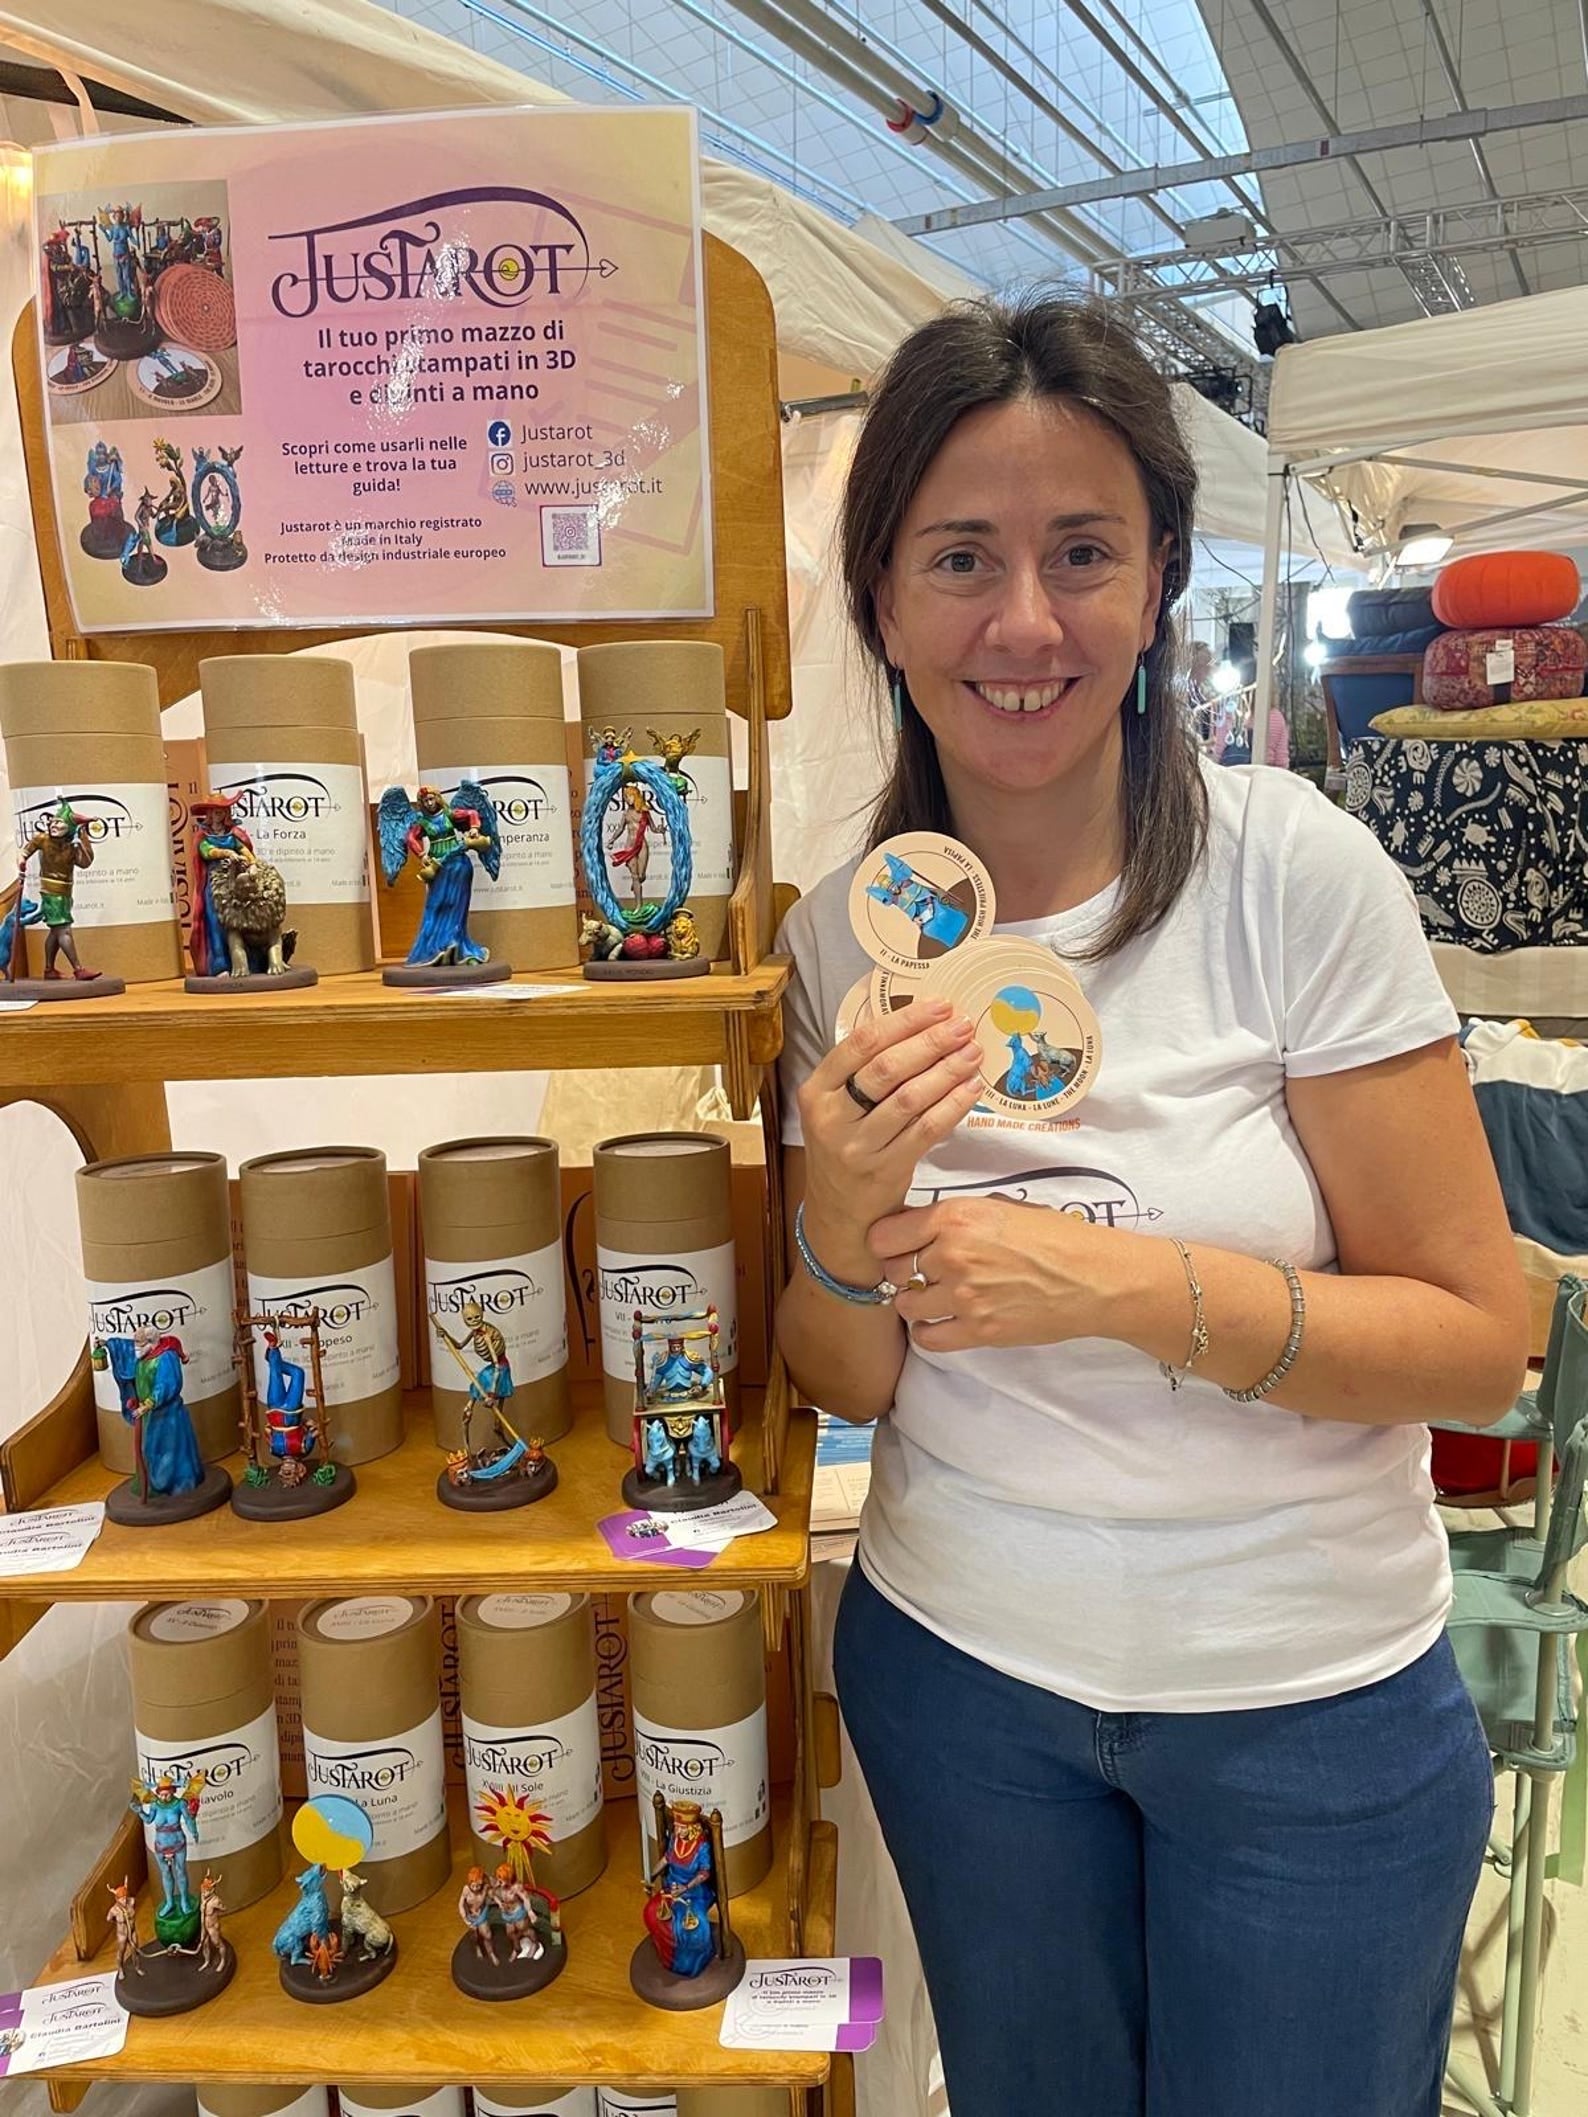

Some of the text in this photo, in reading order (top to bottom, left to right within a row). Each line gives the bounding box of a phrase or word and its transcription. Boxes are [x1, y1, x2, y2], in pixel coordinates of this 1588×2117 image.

[268, 187, 588, 318] JUSTAROT
[317, 328, 332, 349] Il
[338, 328, 378, 348] tuo
[460, 325, 536, 343] mazzo
[542, 319, 565, 341] di
[516, 349, 540, 370] in
[545, 349, 577, 370] 3D
[349, 388, 363, 405] e
[452, 385, 466, 402] a
[472, 382, 540, 401] mano
[520, 424, 593, 445] Justarot
[281, 435, 468, 460] Scopri come usarli nelle
[294, 456, 457, 475] letture e trova la tua
[522, 449, 626, 472] justarot_3d
[352, 477, 401, 496] guida!
[280, 519, 332, 536] Justarot
[344, 520, 363, 532] un
[364, 516, 417, 532] marchio
[419, 515, 482, 533] registrato
[378, 533, 393, 546] in
[393, 533, 423, 548] Italy
[264, 550, 317, 564] Protetto
[319, 550, 335, 563] da
[381, 546, 451, 562] industriale
[453, 546, 506, 563] europeo
[256, 828, 307, 840] La Forza
[900, 960, 931, 969] PAPESSA
[998, 1097, 1008, 1107] LA
[1008, 1101, 1027, 1112] LUNA
[1032, 1101, 1043, 1112] LA
[1062, 1085, 1077, 1099] THE
[1072, 1069, 1090, 1089] MOON
[967, 1115, 1081, 1133] HAND MADE CREATIONS
[600, 1264, 698, 1311] JUSTAROT
[593, 1606, 637, 1783] JUSTAROT
[464, 1735, 564, 1778] JUSTAROT
[308, 1747, 415, 1792] JUSTAROT
[521, 1782, 544, 1793] Sole
[655, 1779, 667, 1791] La
[667, 1783, 712, 1796] Giustizia
[371, 1794, 398, 1808] Luna
[749, 1966, 837, 1990] JUSTAROT
